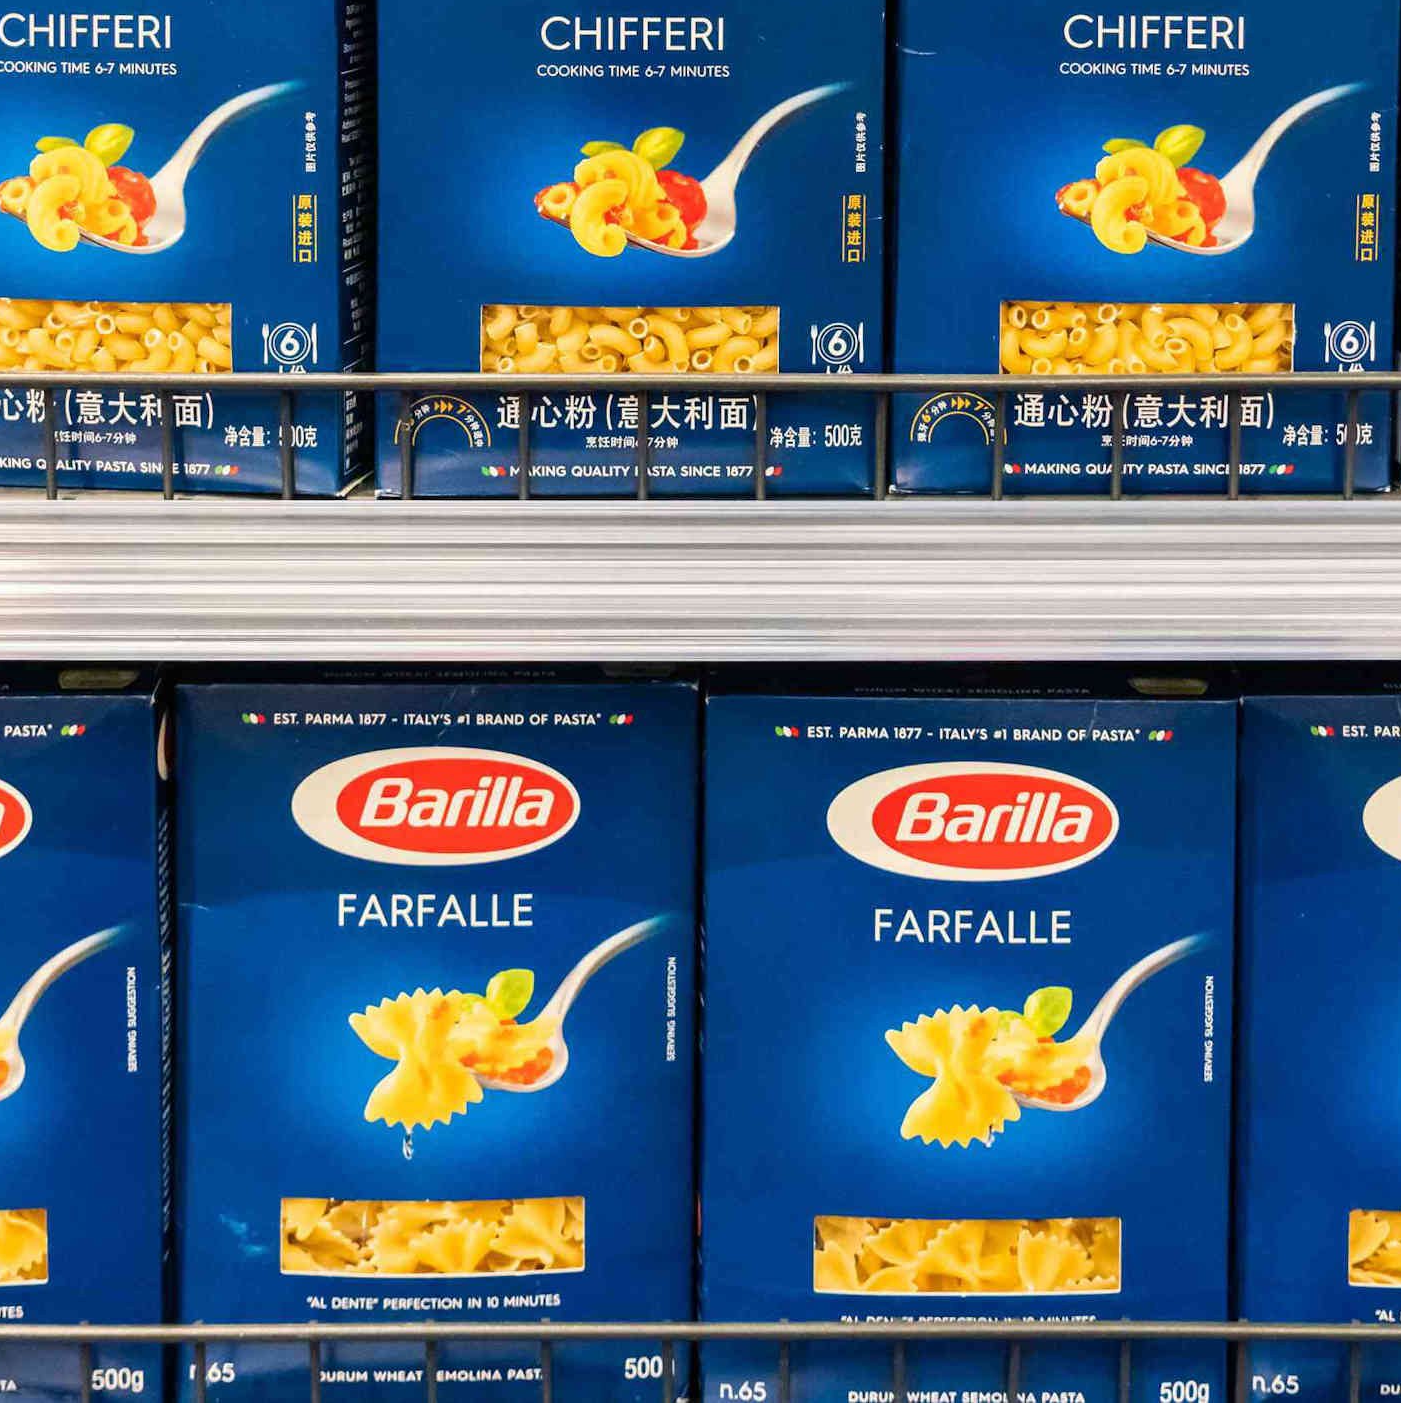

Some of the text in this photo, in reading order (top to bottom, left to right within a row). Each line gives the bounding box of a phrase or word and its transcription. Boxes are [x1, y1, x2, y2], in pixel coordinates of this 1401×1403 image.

[541, 16, 723, 50] CHIFFERI
[1064, 15, 1244, 49] CHIFFERI
[537, 65, 729, 77] COOKING TIME 6-7 MINUTES
[1060, 63, 1249, 76] COOKING TIME 6-7 MINUTES
[298, 194, 312, 262] 原装进口
[848, 195, 861, 262] 原装进口
[828, 333, 845, 355] 6
[824, 424, 862, 447] 500克
[35, 458, 92, 471] QALITY
[96, 460, 136, 472] PASTA
[140, 462, 179, 474] SINE
[184, 464, 210, 475] 1877
[571, 466, 753, 477] QUALITY SINCE 1877
[274, 713, 298, 724] EST.
[306, 714, 353, 724] PARMA
[359, 714, 386, 724] 1877
[457, 714, 470, 725] #1
[477, 714, 524, 725] BRAND
[529, 714, 548, 725] OF
[808, 726, 833, 738] EST.
[840, 727, 889, 738] PARMA
[894, 727, 921, 739] 1877
[994, 729, 1006, 739] #1
[1014, 729, 1062, 741] BRAND
[1067, 729, 1086, 741] OF
[359, 776, 554, 828] Barilla
[896, 792, 1093, 843] Barilla
[339, 894, 532, 926] FARFALLE
[875, 909, 1070, 943] FARFALLE
[667, 957, 676, 1061] SUGGESTION SERVING
[383, 1298, 462, 1310] PERFECTION
[468, 1298, 482, 1308] IN
[487, 1296, 499, 1308] 10
[504, 1294, 560, 1307] MINUTES
[92, 1368, 143, 1392] 500g
[720, 1382, 766, 1401] n.65
[1160, 1380, 1209, 1403] 500g
[1253, 1375, 1298, 1394] n.65
